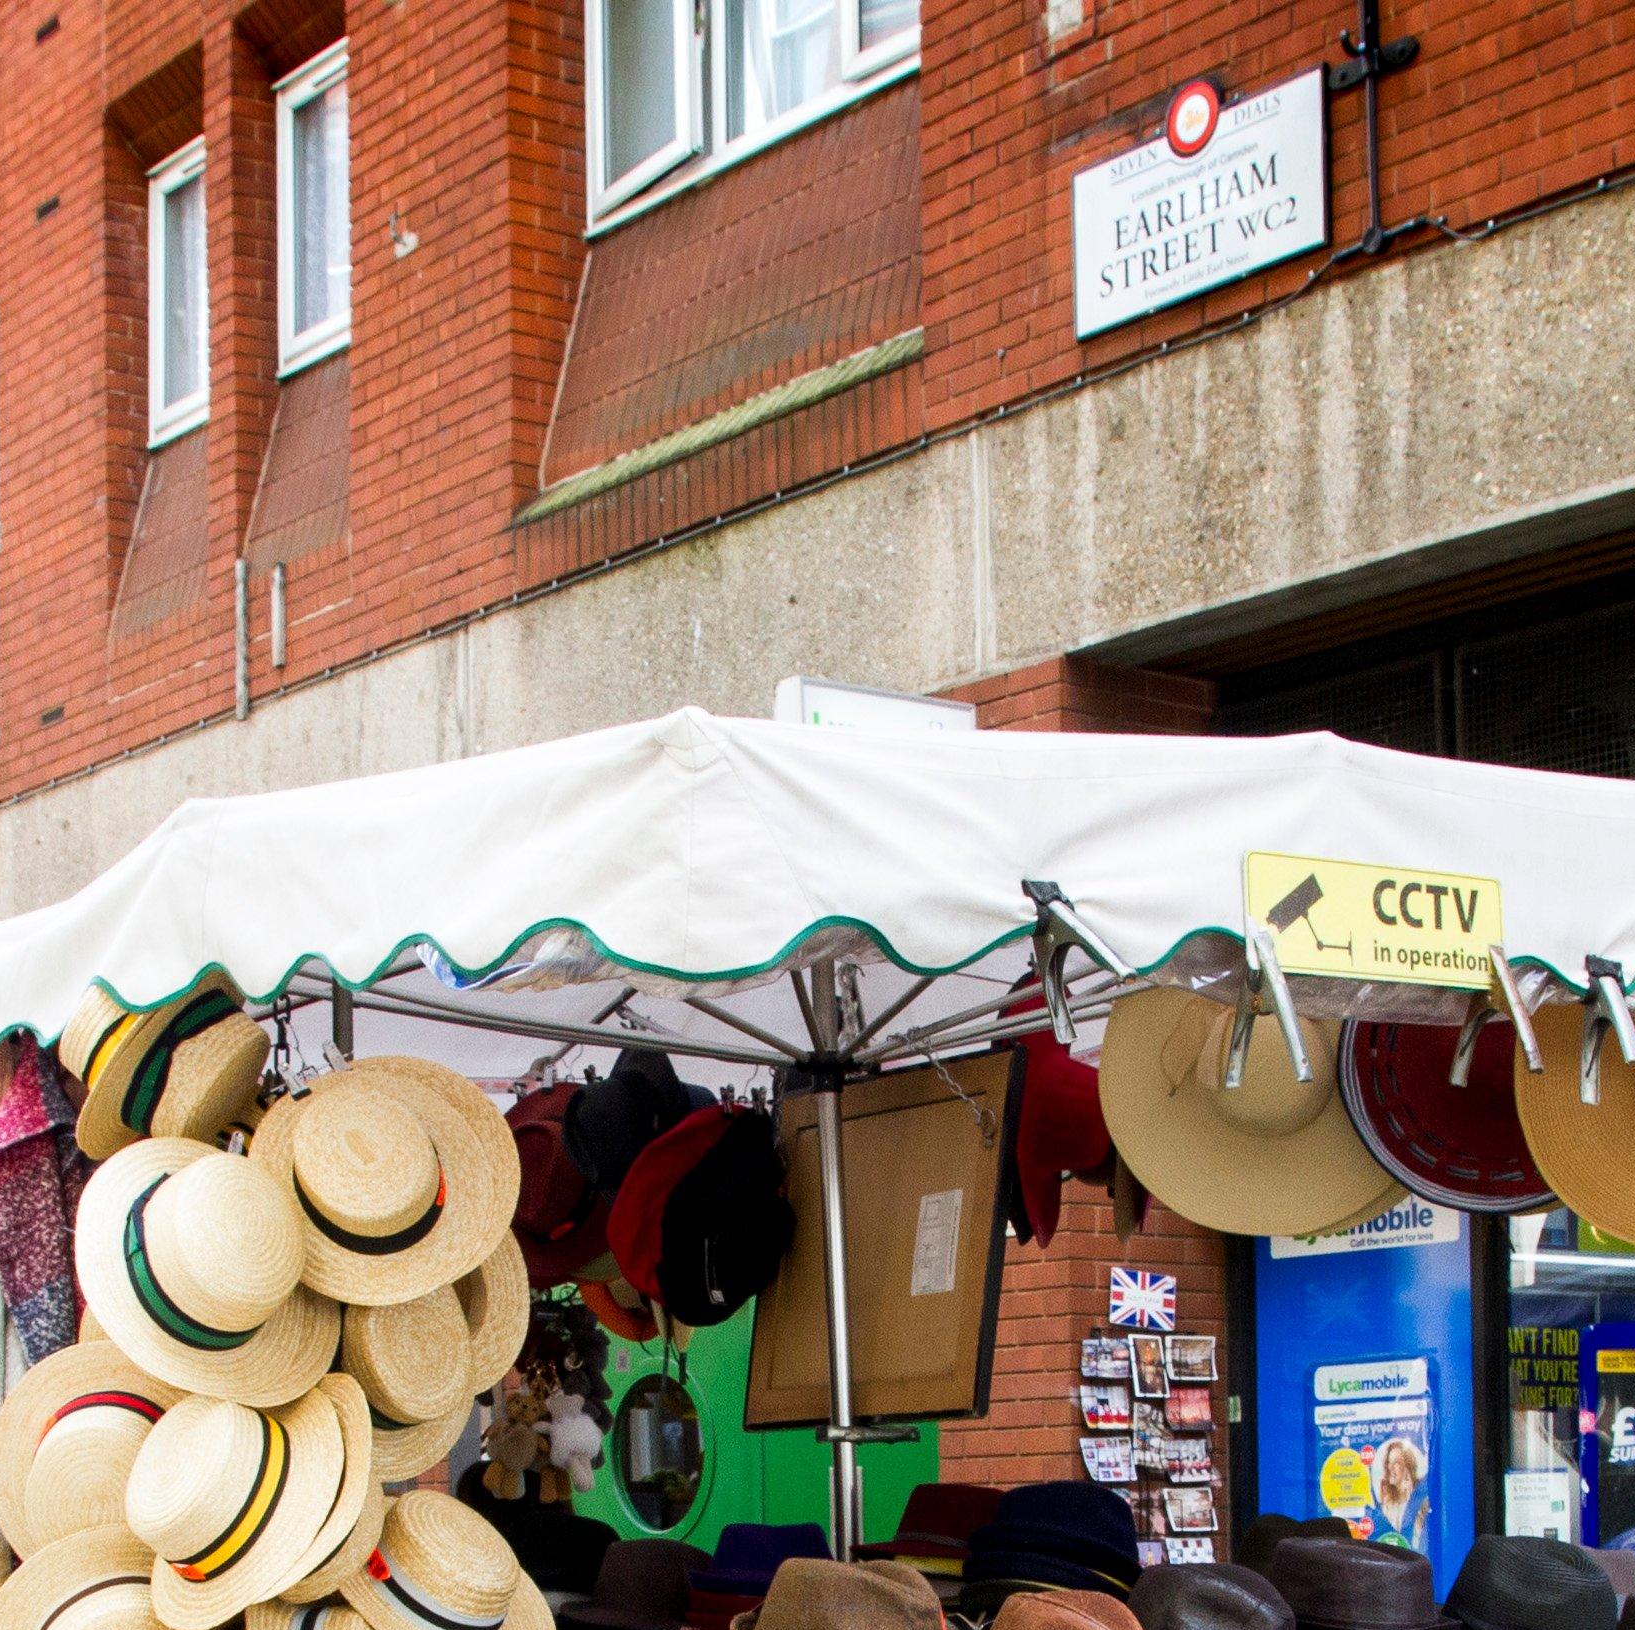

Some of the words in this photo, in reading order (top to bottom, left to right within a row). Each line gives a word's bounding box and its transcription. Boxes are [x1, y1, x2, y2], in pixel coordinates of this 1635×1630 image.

[1110, 147, 1157, 178] SEVEN
[1234, 94, 1281, 125] DIALS
[1114, 152, 1278, 250] EARLHAM
[1099, 217, 1224, 299] STREET
[1238, 192, 1297, 244] WC2
[1372, 879, 1478, 933] CCTV
[1373, 939, 1391, 963] in
[1396, 947, 1489, 971] operation
[1542, 1329, 1579, 1356] FIND
[1329, 1374, 1409, 1395] Lycamobile
[1318, 1425, 1343, 1437] Your
